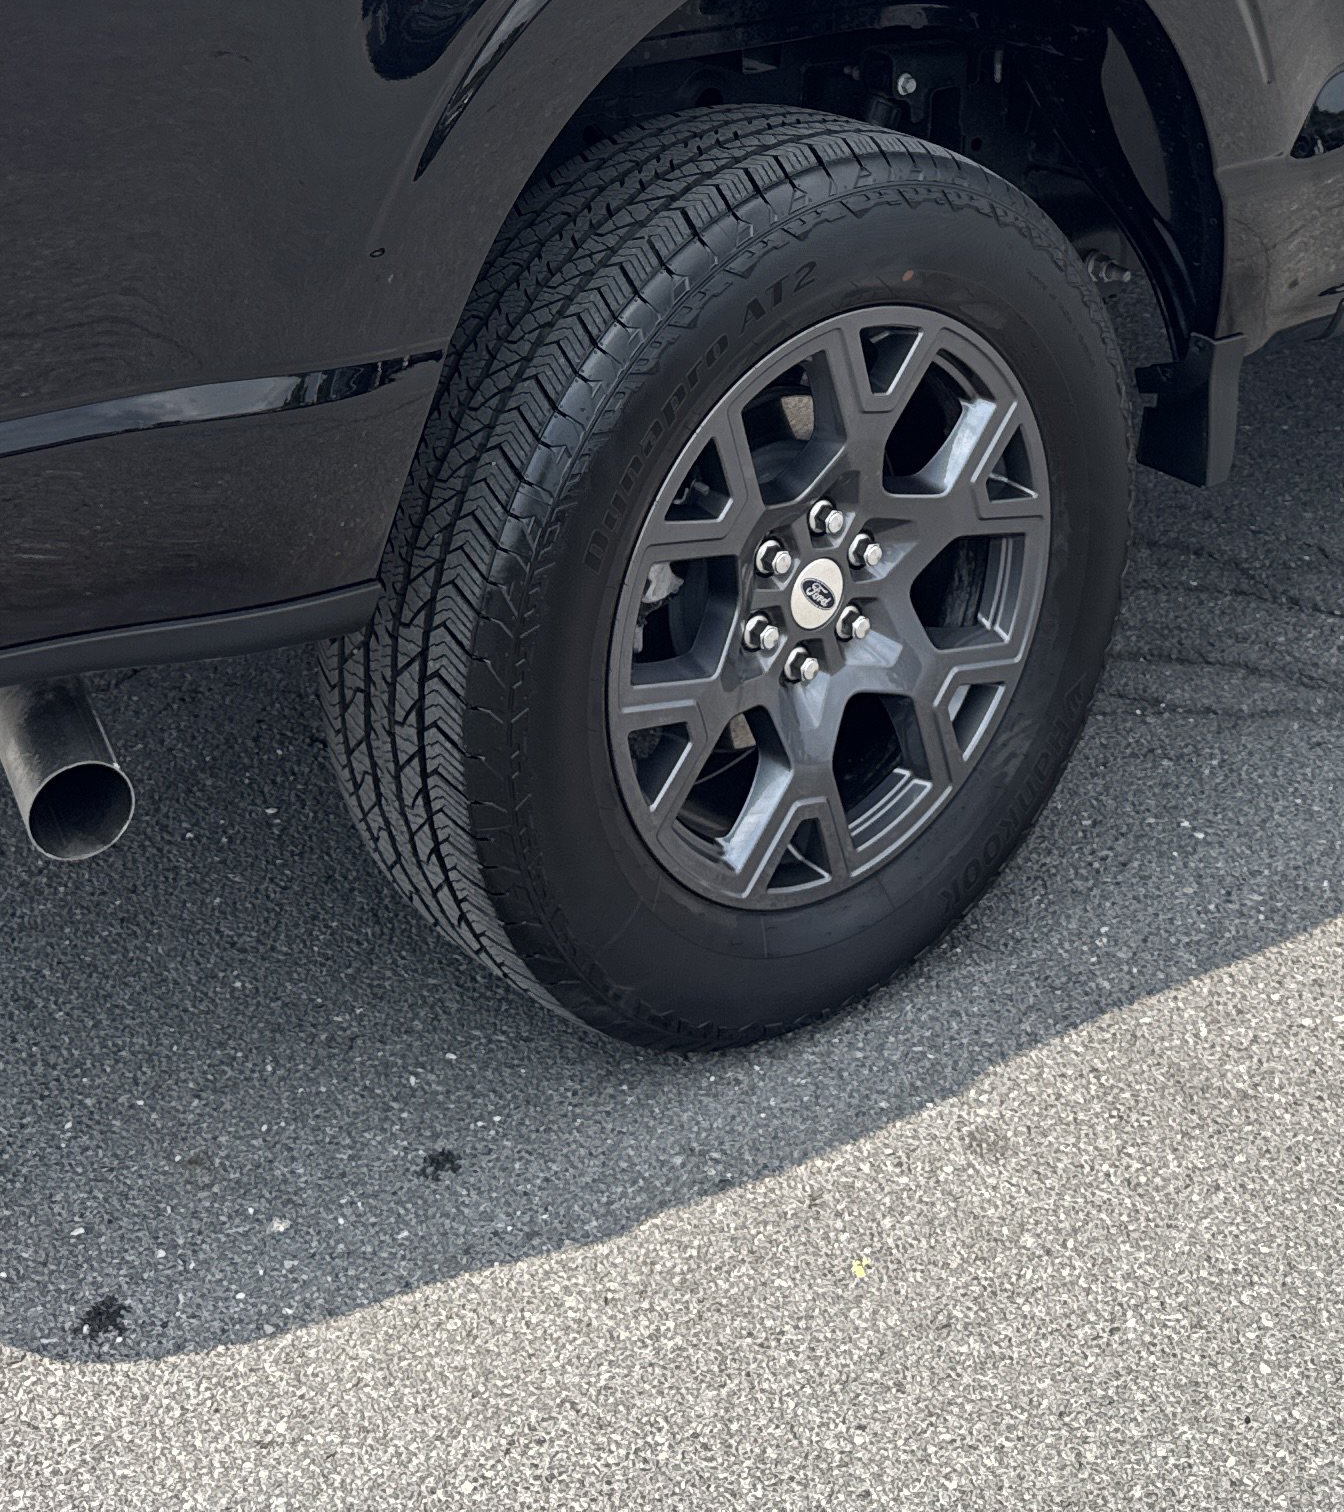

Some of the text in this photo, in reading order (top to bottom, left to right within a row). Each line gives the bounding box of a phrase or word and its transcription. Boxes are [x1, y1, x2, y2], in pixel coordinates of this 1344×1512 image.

[582, 261, 817, 575] Dynapro AT2
[806, 582, 832, 607] Ford
